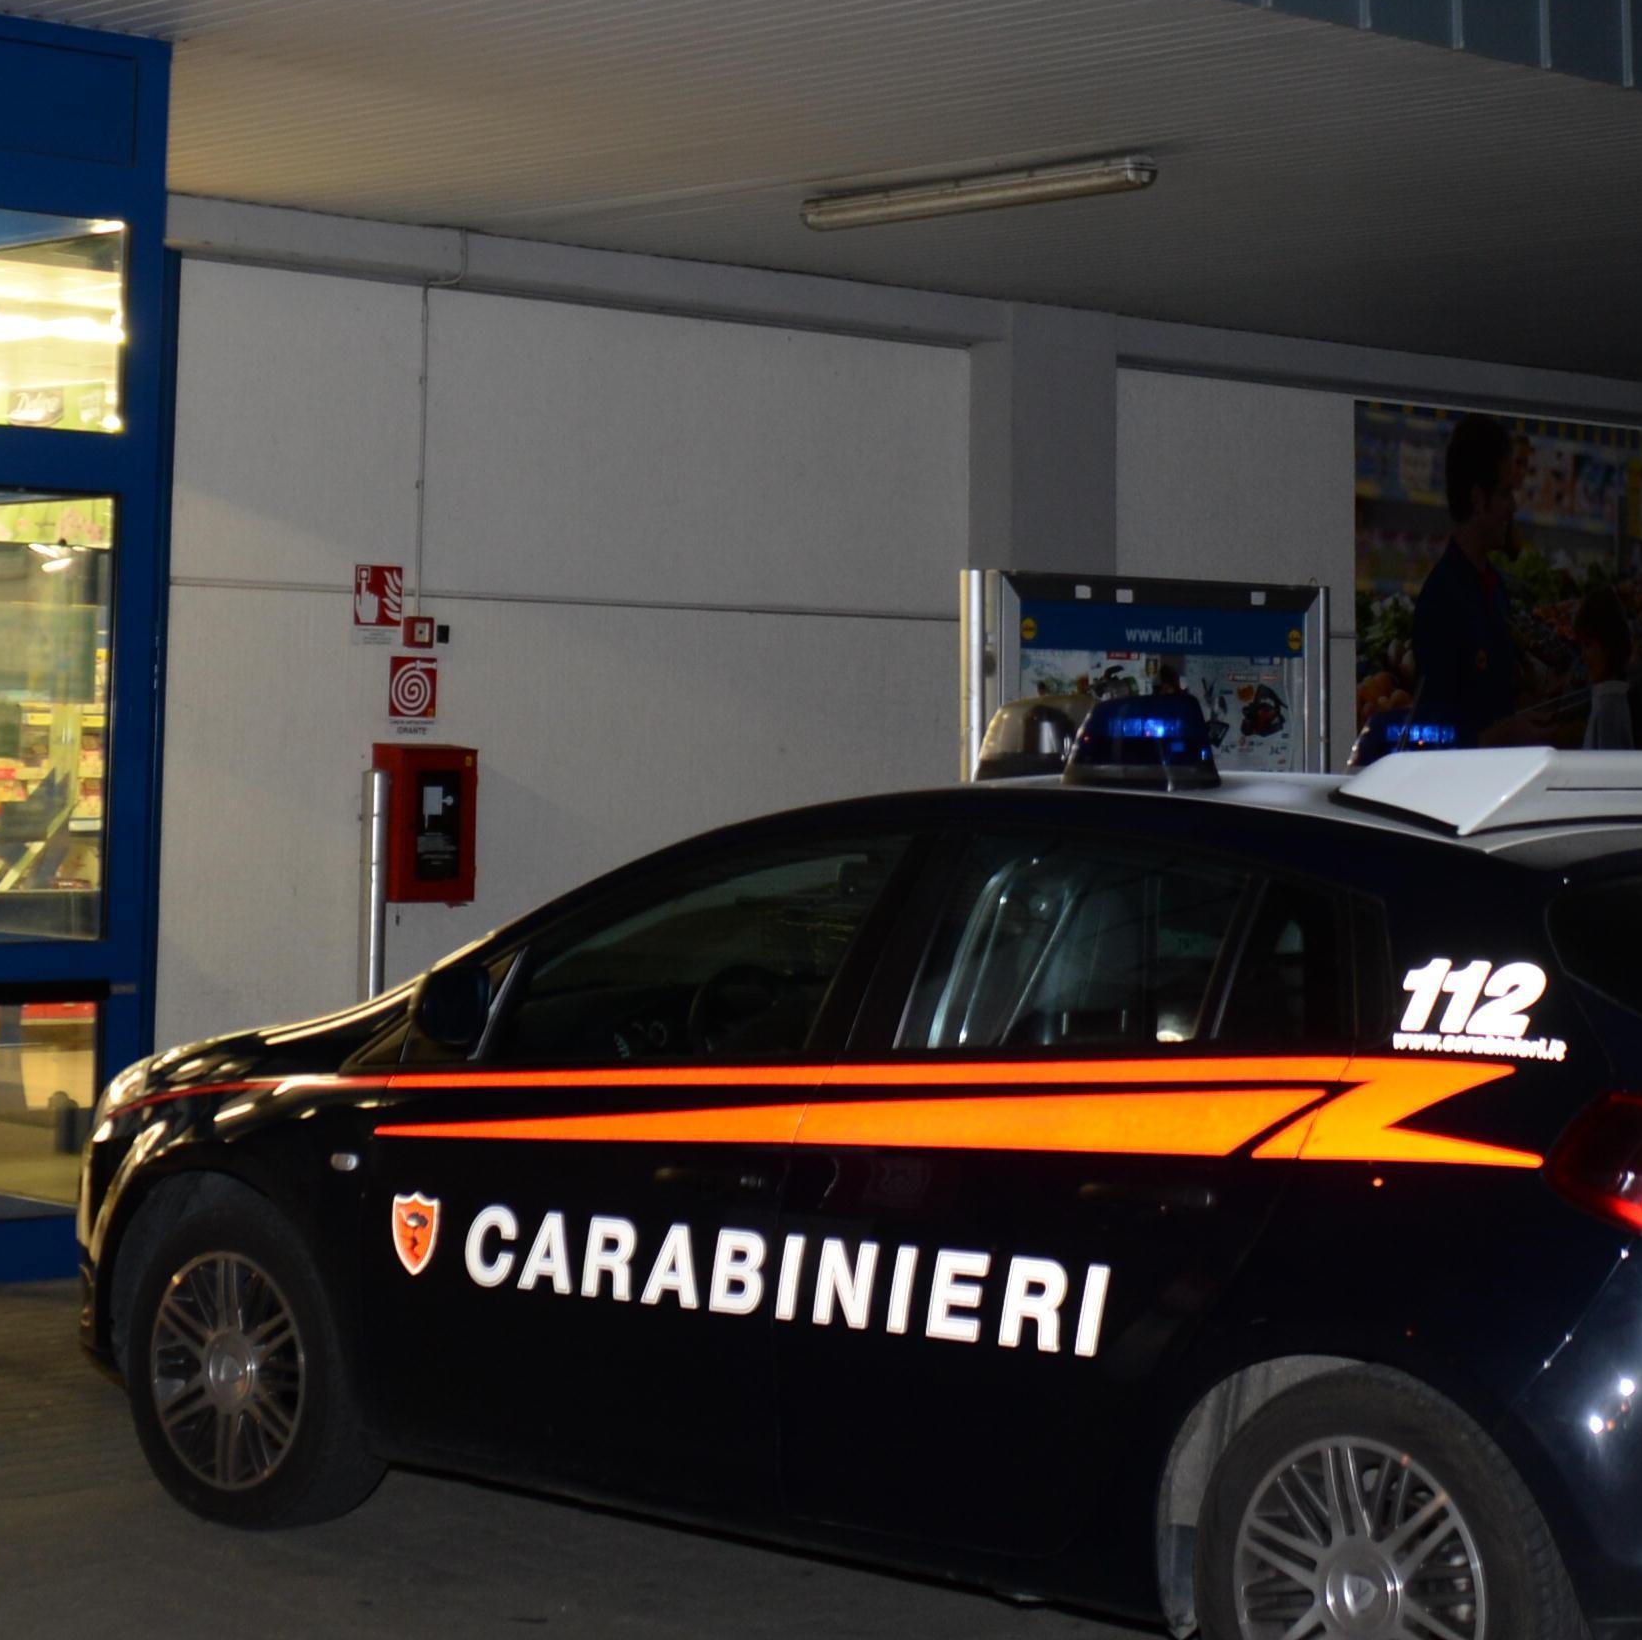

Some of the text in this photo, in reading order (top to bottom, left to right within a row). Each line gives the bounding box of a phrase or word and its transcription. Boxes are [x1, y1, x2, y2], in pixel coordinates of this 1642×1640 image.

[1125, 626, 1204, 646] www.lidl.it
[396, 726, 428, 735] IDRANTE
[1400, 958, 1547, 1037] 112
[464, 1203, 1112, 1358] CARABINIERI
